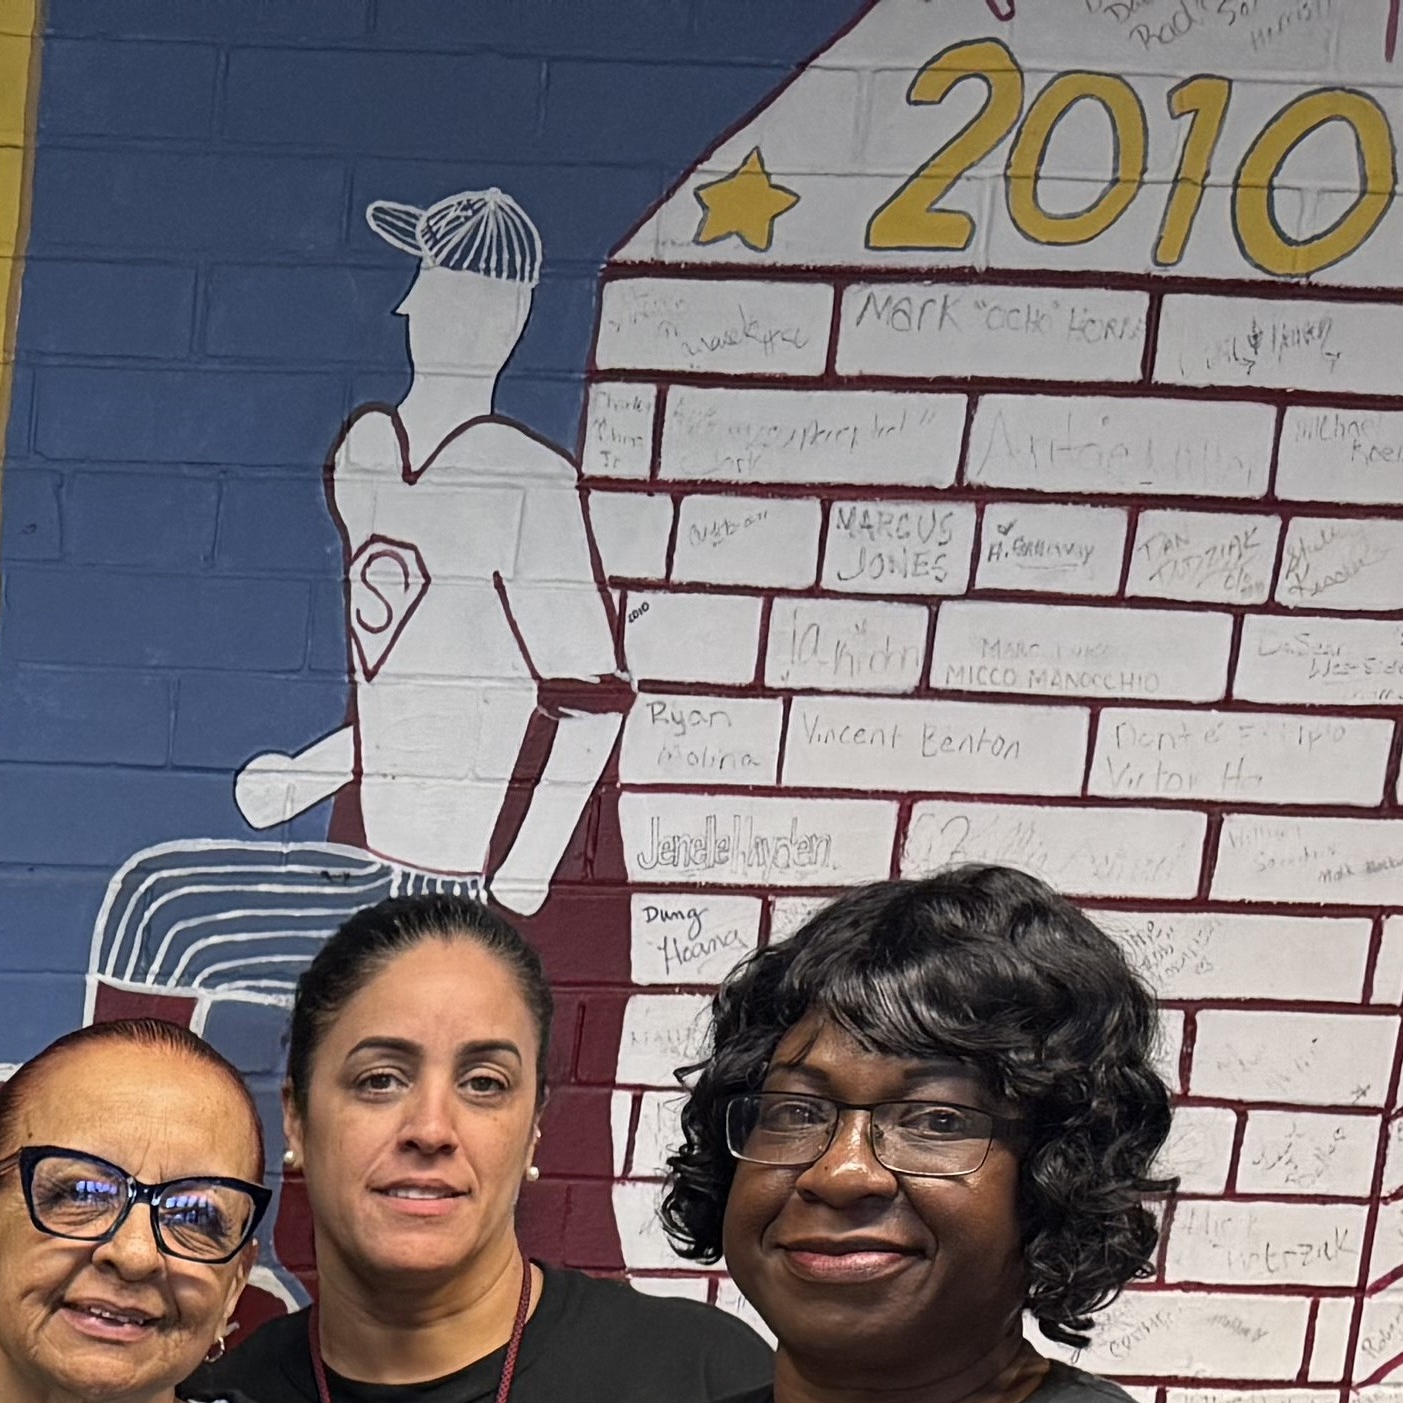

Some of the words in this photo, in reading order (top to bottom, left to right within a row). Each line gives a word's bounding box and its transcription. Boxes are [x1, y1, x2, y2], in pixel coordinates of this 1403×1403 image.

[865, 37, 1398, 277] 2010
[646, 700, 733, 738] Ryan
[642, 905, 709, 942] Dung
